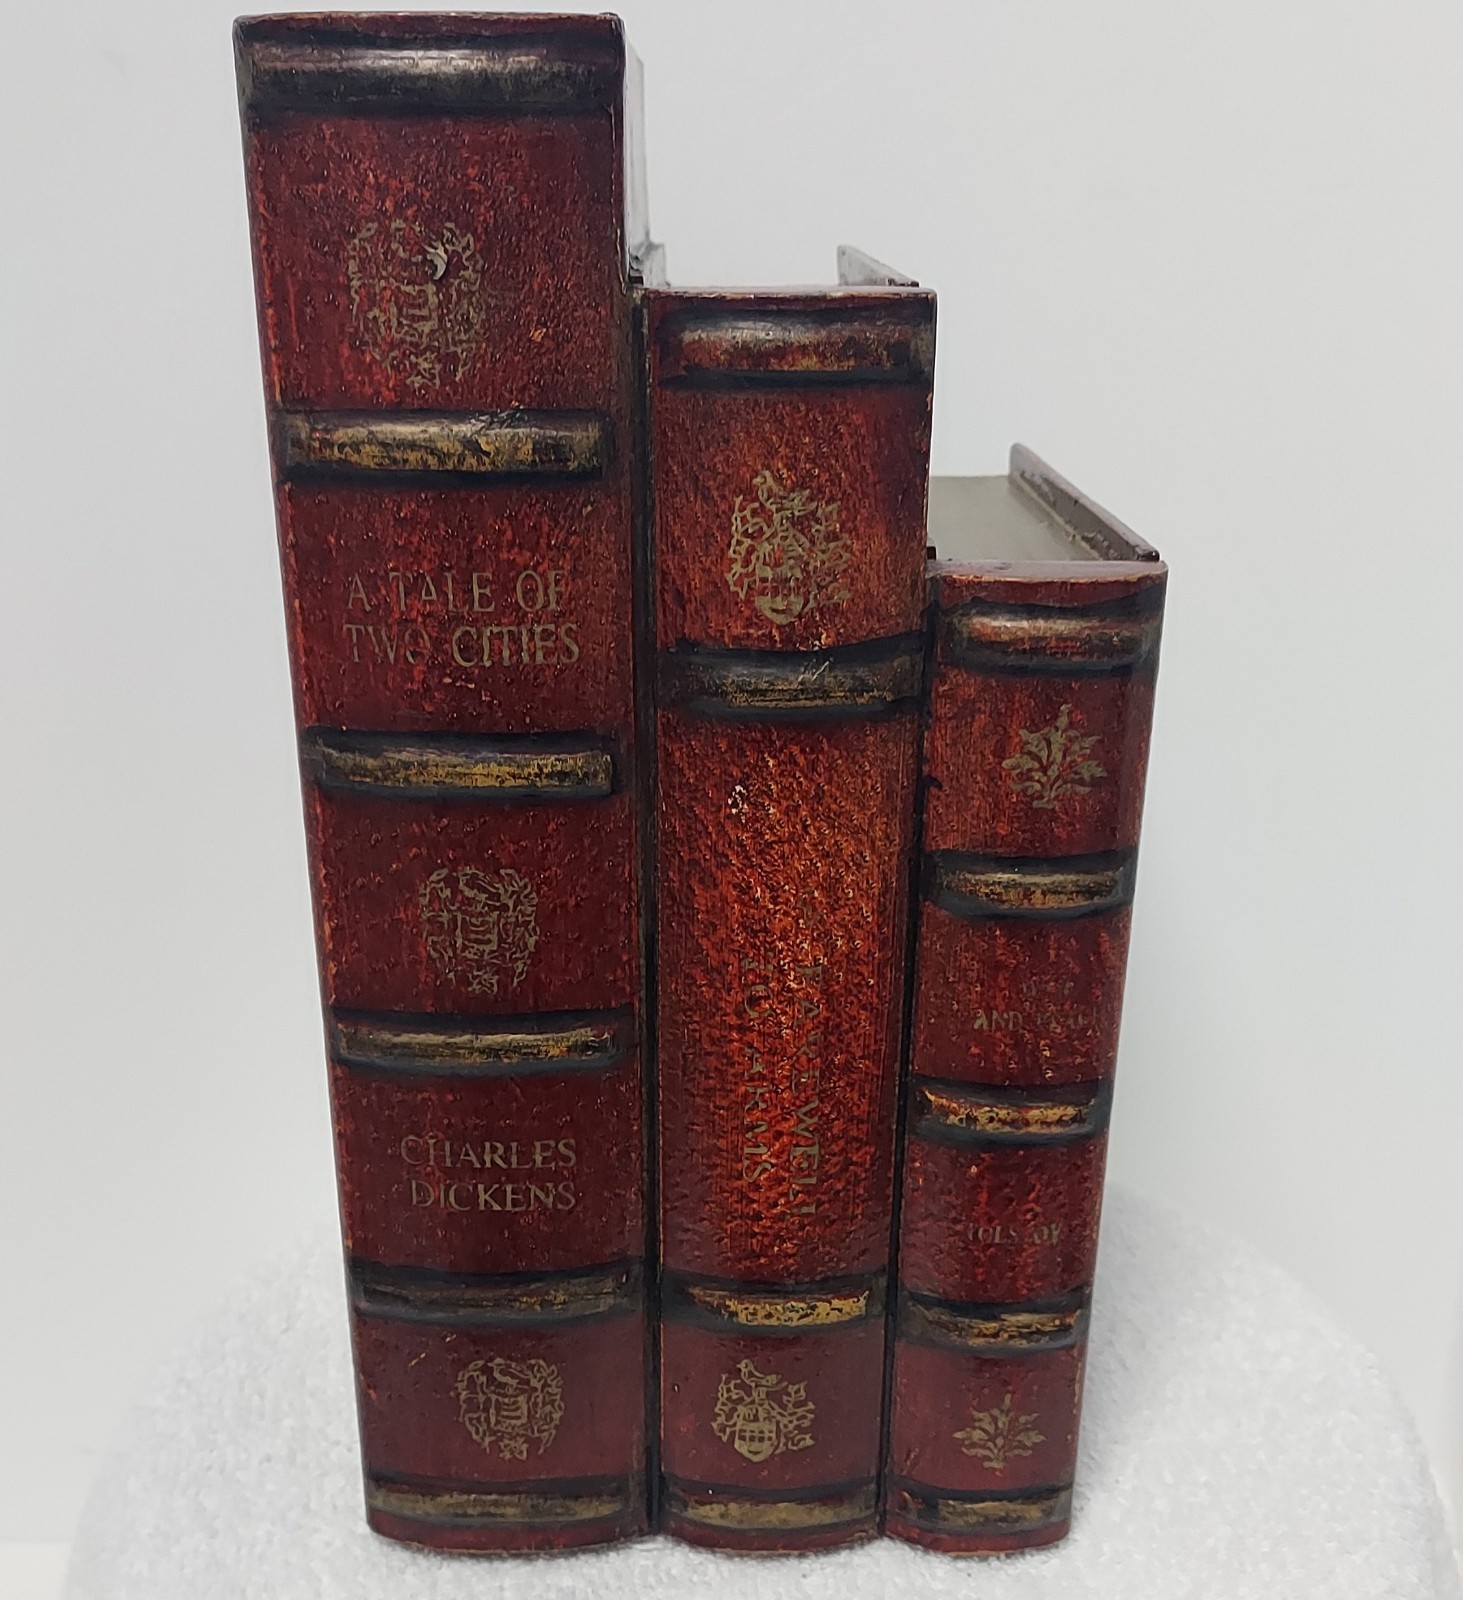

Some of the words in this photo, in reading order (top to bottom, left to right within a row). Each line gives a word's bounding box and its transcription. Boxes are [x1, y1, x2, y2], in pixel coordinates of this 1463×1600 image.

[346, 571, 372, 612] A
[388, 570, 496, 612] TALE
[515, 569, 568, 612] OF
[342, 623, 431, 665] TWO
[451, 621, 580, 667] CITIES
[973, 1010, 1024, 1031] AND
[740, 1048, 773, 1184] ARMS
[400, 1133, 577, 1169] CHARLES
[410, 1179, 577, 1212] DICKENS
